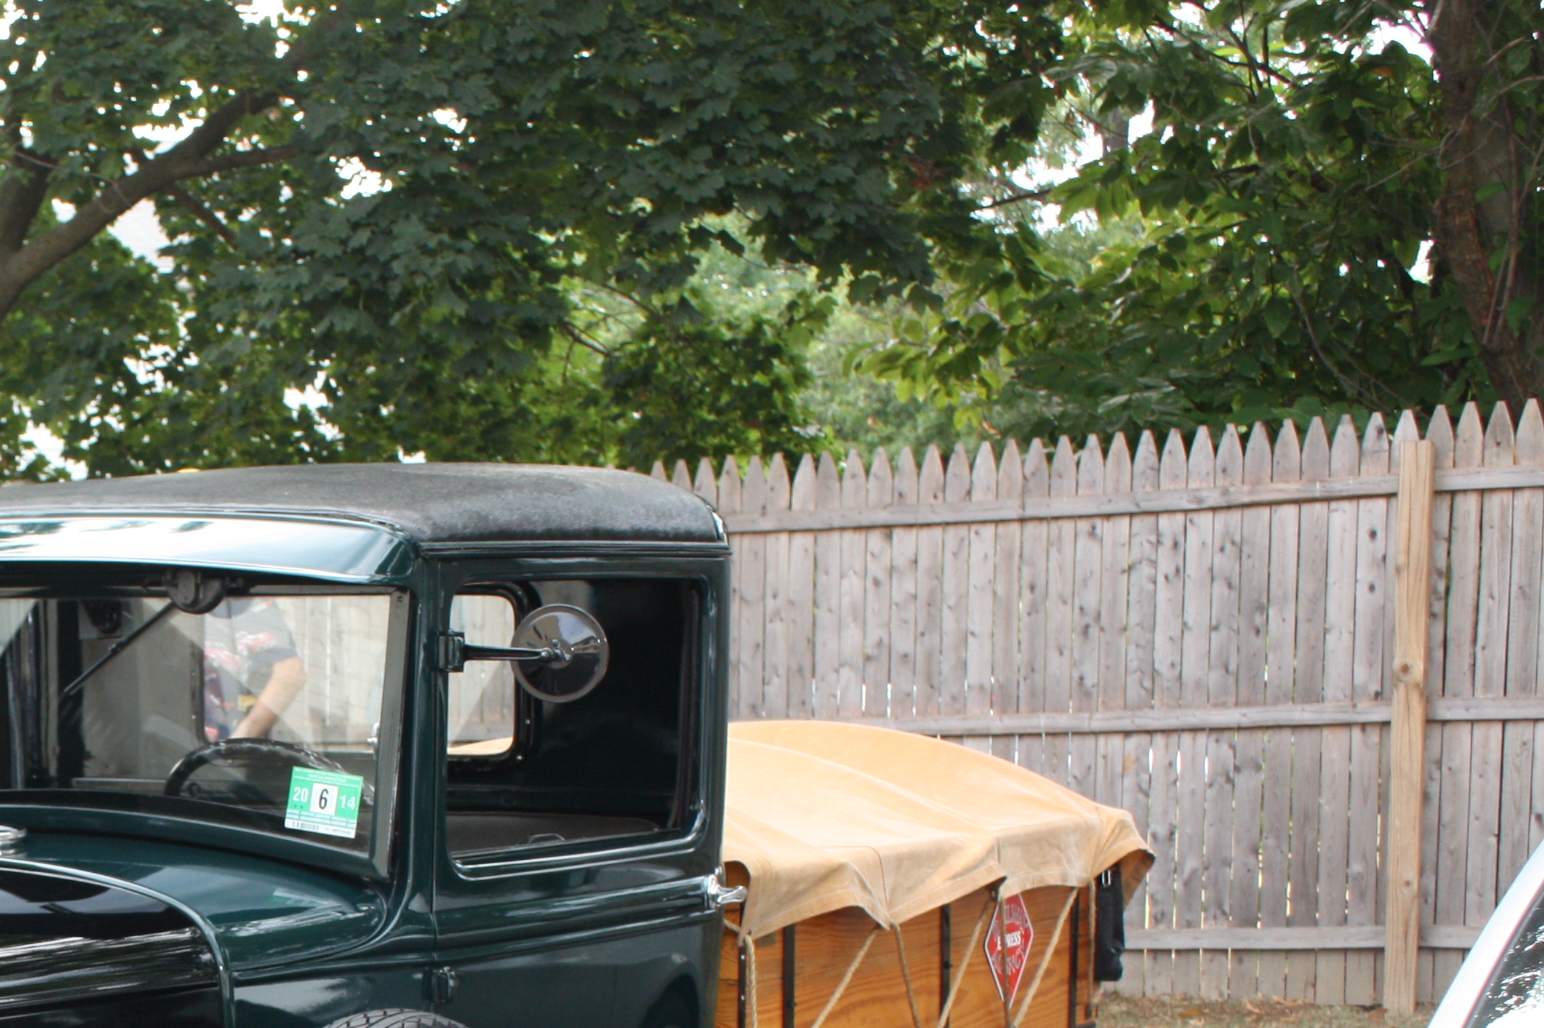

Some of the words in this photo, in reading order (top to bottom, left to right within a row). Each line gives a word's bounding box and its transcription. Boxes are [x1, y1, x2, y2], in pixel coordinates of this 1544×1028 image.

[292, 787, 309, 803] 20
[318, 788, 329, 810] 6
[340, 795, 356, 810] 14
